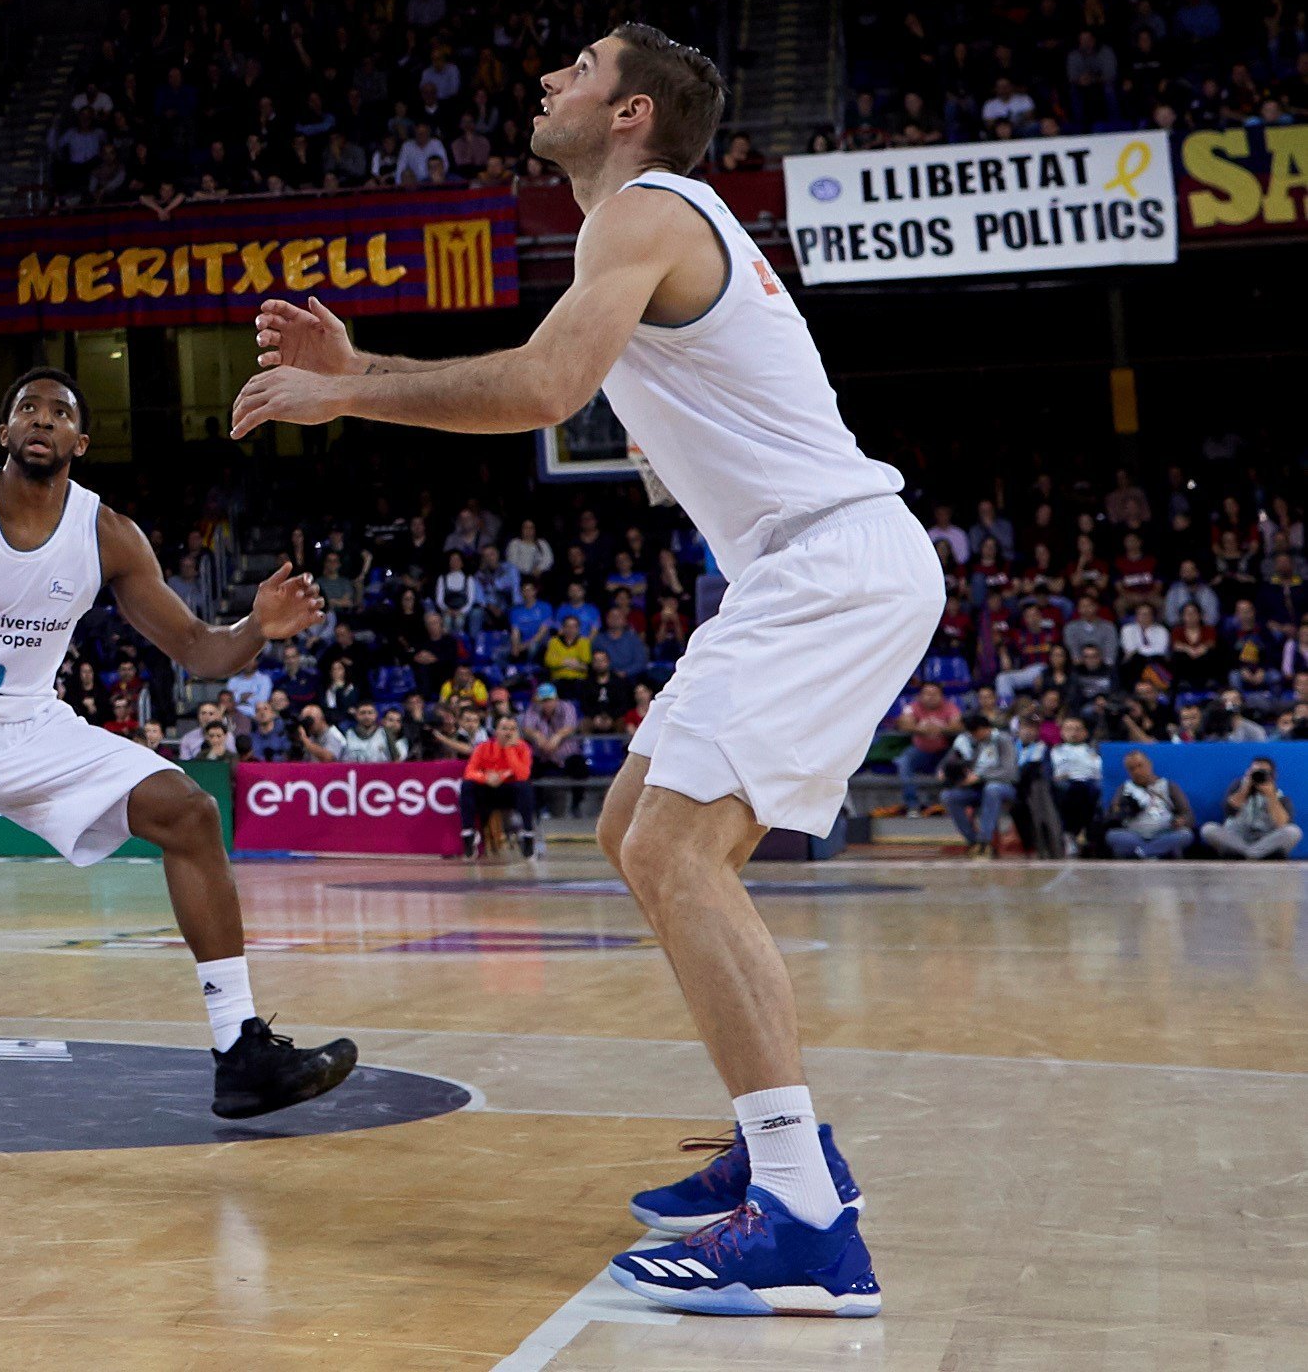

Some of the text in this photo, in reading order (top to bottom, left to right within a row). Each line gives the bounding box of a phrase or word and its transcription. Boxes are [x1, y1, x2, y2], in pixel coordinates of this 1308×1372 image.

[861, 150, 1090, 204] LLIBERTAT
[797, 198, 1165, 266] PRESOS POLÍTICS
[18, 232, 407, 306] MERITXELL
